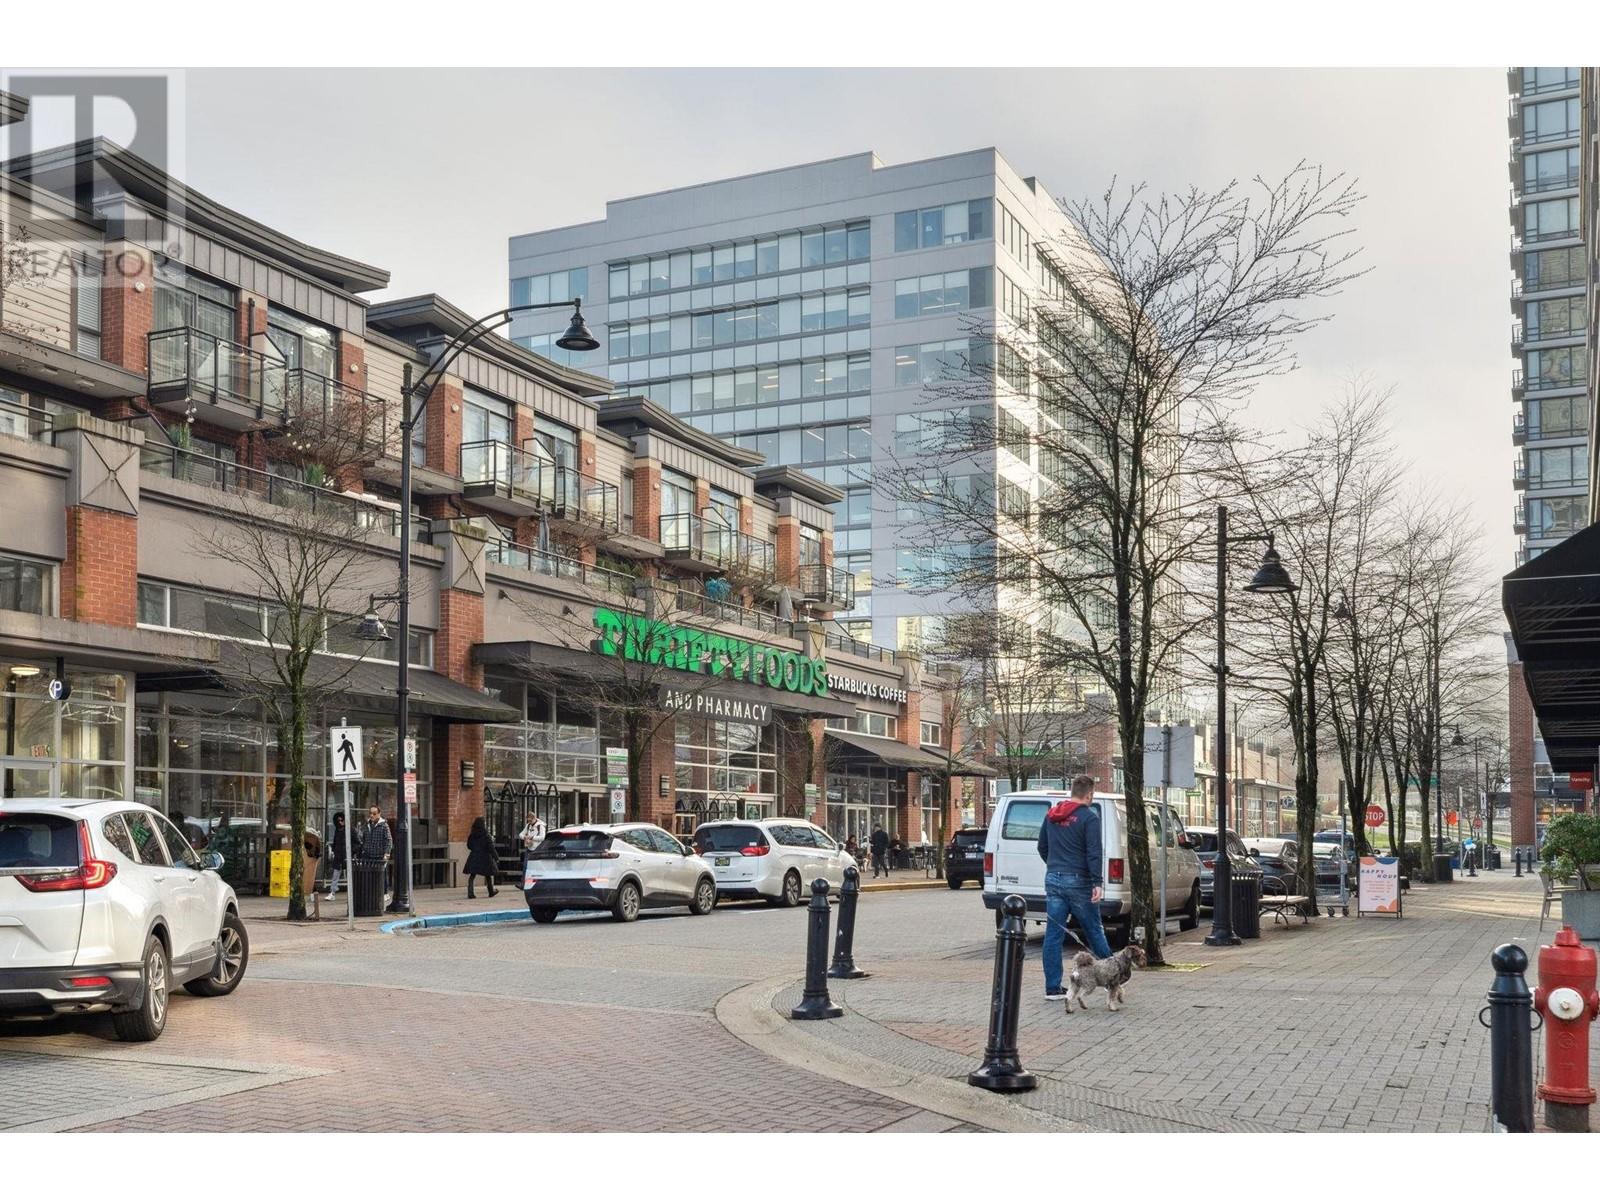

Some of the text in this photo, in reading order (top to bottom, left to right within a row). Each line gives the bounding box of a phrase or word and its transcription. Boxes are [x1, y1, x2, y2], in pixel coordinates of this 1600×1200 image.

[590, 607, 828, 697] THRIFTY FOODS
[53, 681, 62, 699] P
[828, 674, 907, 703] STARBUCKS COFFEE
[665, 690, 767, 721] AND PHARMACY
[1366, 812, 1383, 820] STOP
